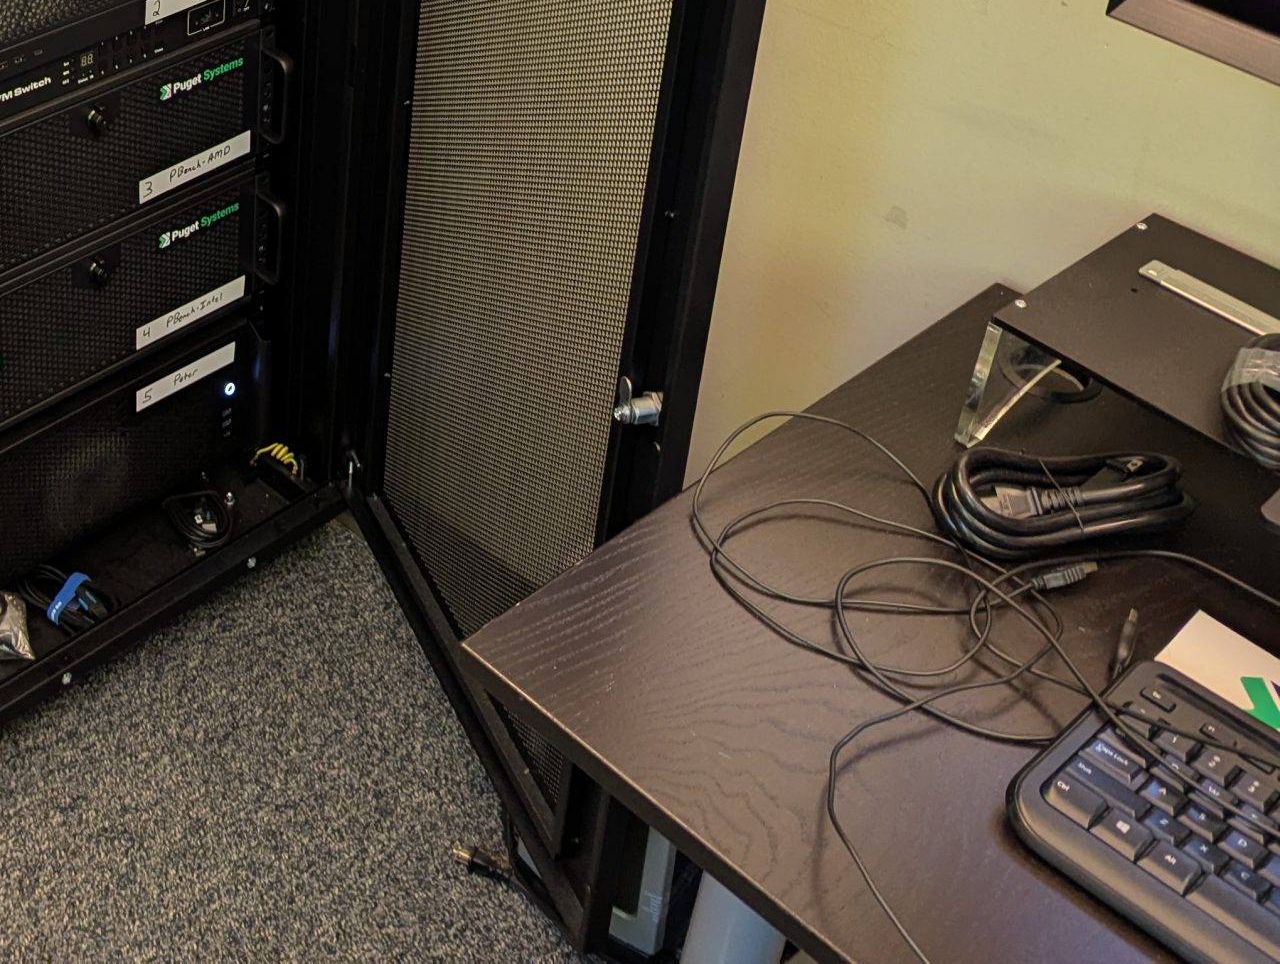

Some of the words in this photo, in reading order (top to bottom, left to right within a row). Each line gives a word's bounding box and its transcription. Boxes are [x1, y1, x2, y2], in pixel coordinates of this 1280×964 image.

[152, 0, 161, 17] 2
[173, 73, 202, 94] Puget
[203, 57, 244, 81] Systems
[13, 76, 52, 97] Switch
[143, 181, 153, 199] 3
[171, 220, 200, 242] Puget
[200, 202, 240, 227] Systems
[142, 327, 151, 338] 4
[142, 388, 153, 404] 5
[173, 369, 199, 387] Peter
[1057, 780, 1070, 792] Ctrl
